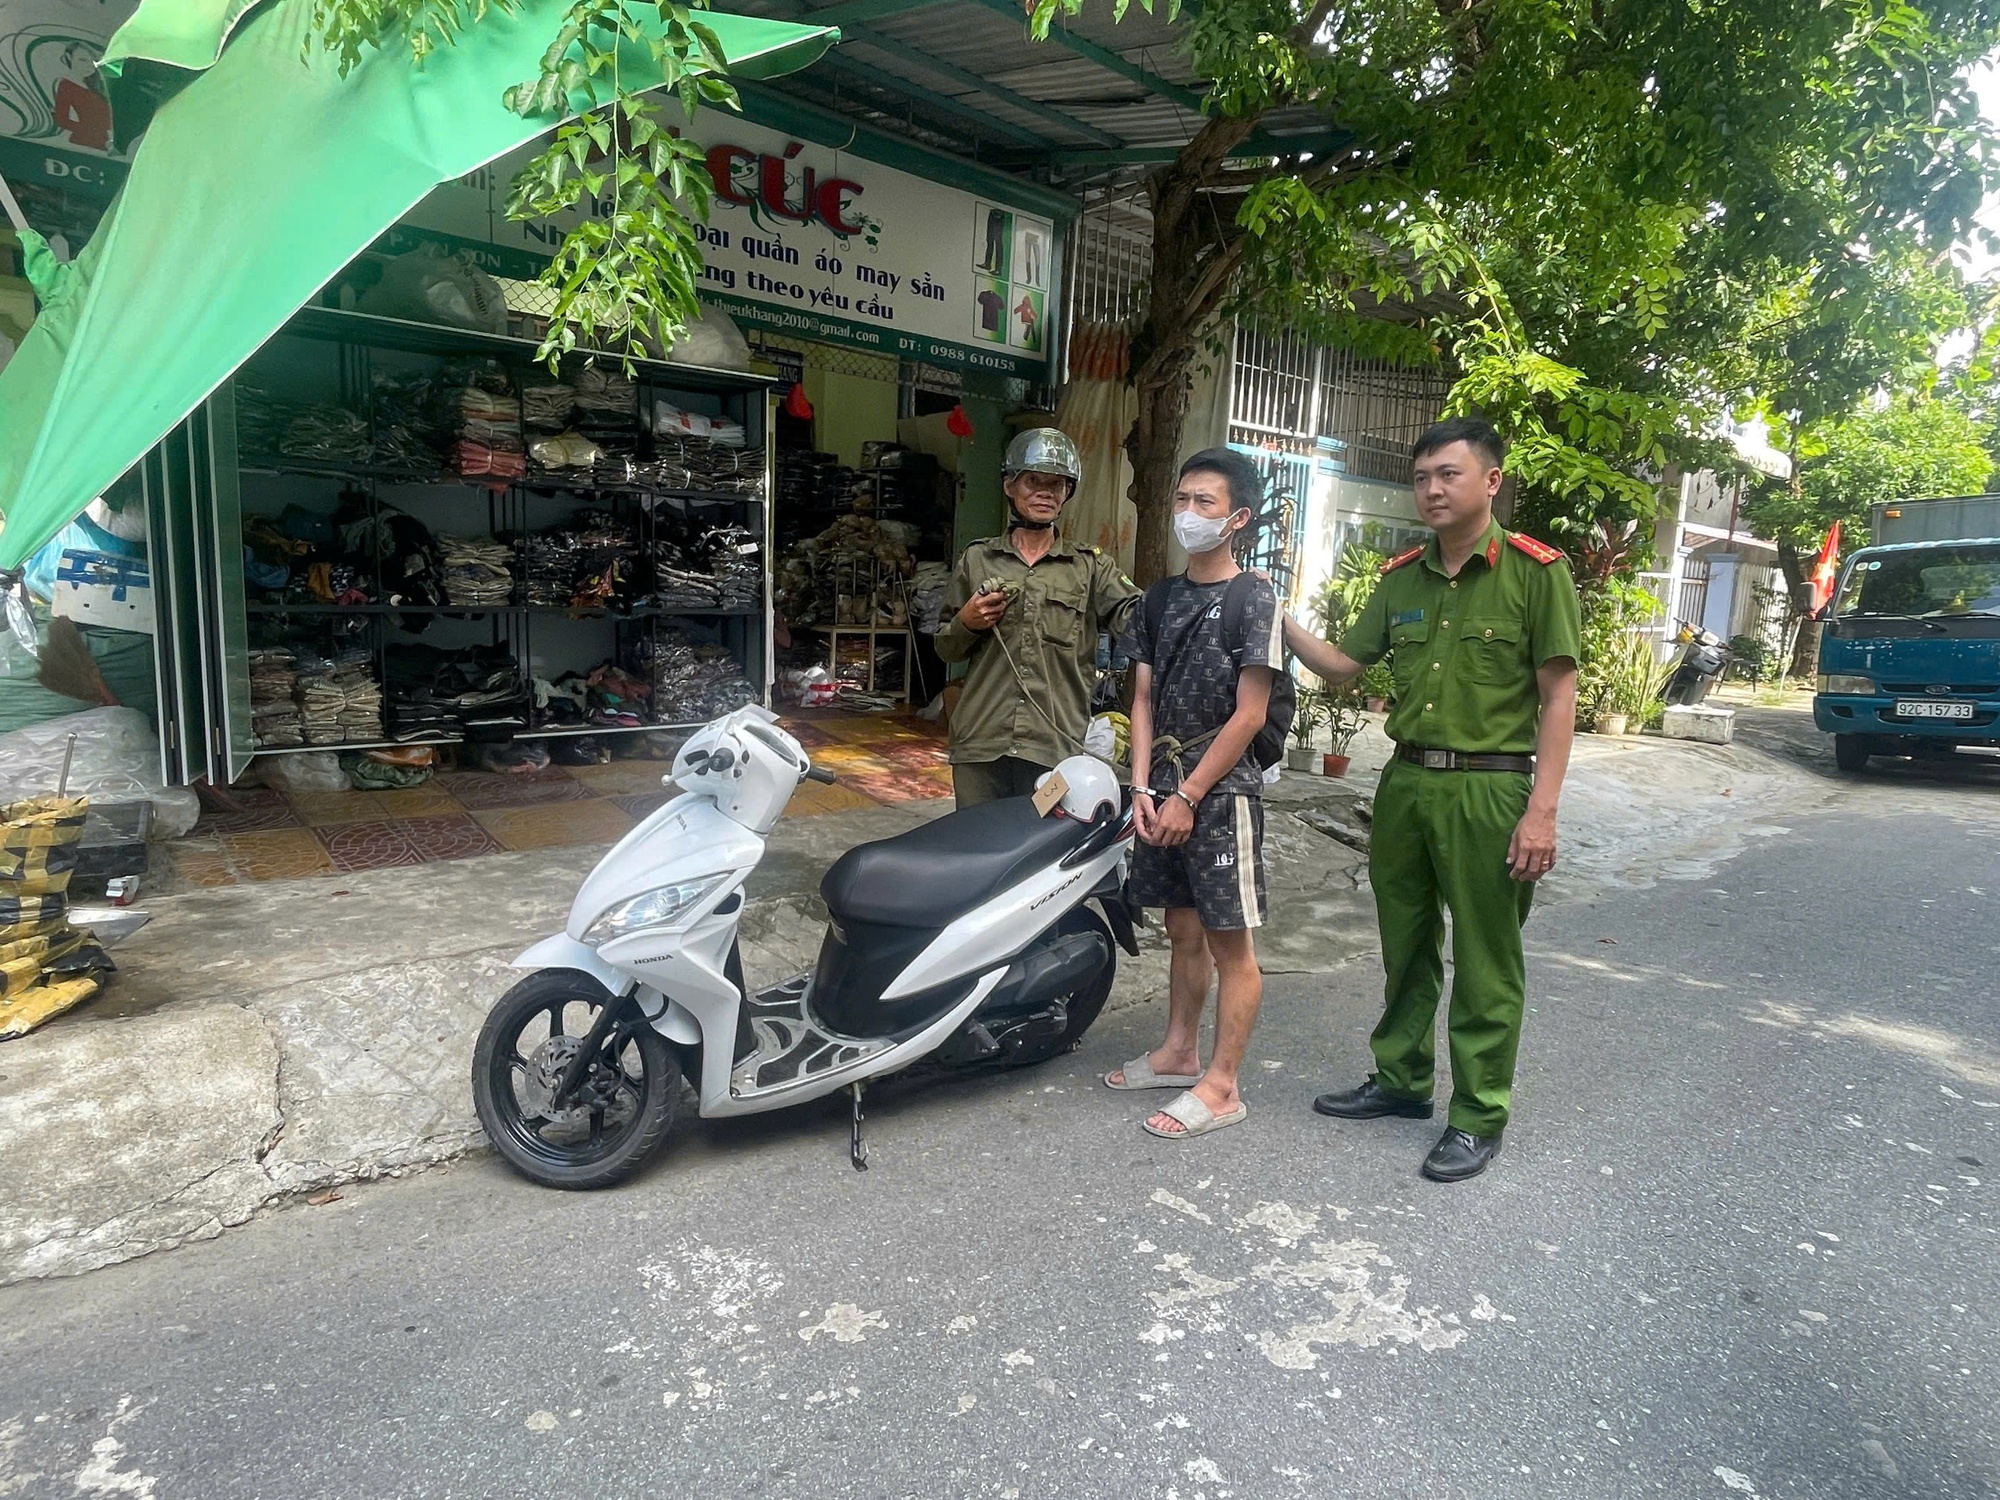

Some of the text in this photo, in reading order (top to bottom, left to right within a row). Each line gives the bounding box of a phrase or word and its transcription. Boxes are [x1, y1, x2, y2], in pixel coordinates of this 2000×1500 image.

[741, 233, 798, 265] quần
[814, 248, 842, 275] áo
[856, 264, 901, 294] may
[747, 270, 804, 299] theo
[808, 286, 849, 310] yêu
[855, 293, 894, 320] cầu
[930, 344, 965, 361] 0988
[969, 352, 1016, 372] 610158
[1030, 871, 1083, 911] VISION
[633, 954, 674, 965] HONDA
